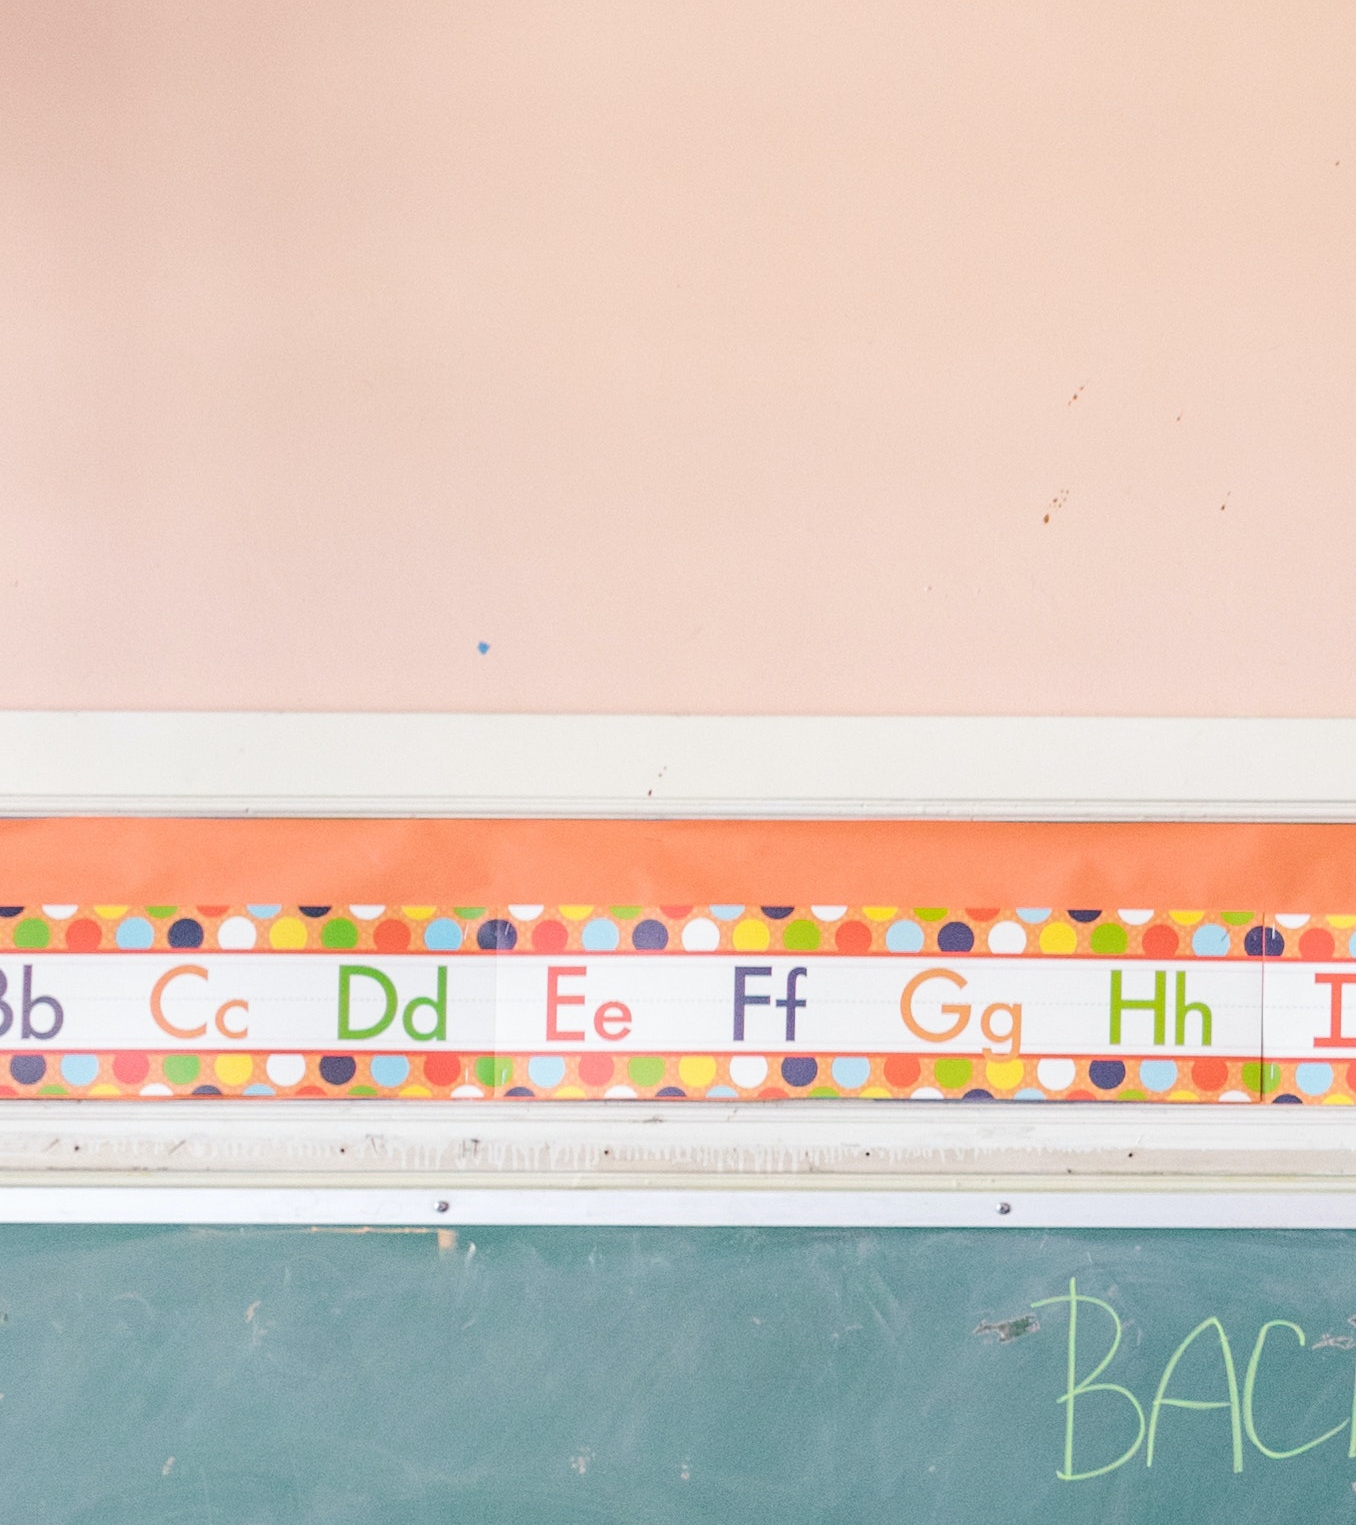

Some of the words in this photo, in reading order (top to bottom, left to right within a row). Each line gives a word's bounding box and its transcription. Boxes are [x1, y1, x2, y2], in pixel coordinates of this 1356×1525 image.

[0, 964, 64, 1040] b
[151, 965, 248, 1039] Cc
[338, 964, 448, 1042] Dd
[547, 966, 631, 1041] Ee
[733, 966, 808, 1042] Ff
[901, 968, 1021, 1062] Gg
[1109, 969, 1212, 1046] Hh
